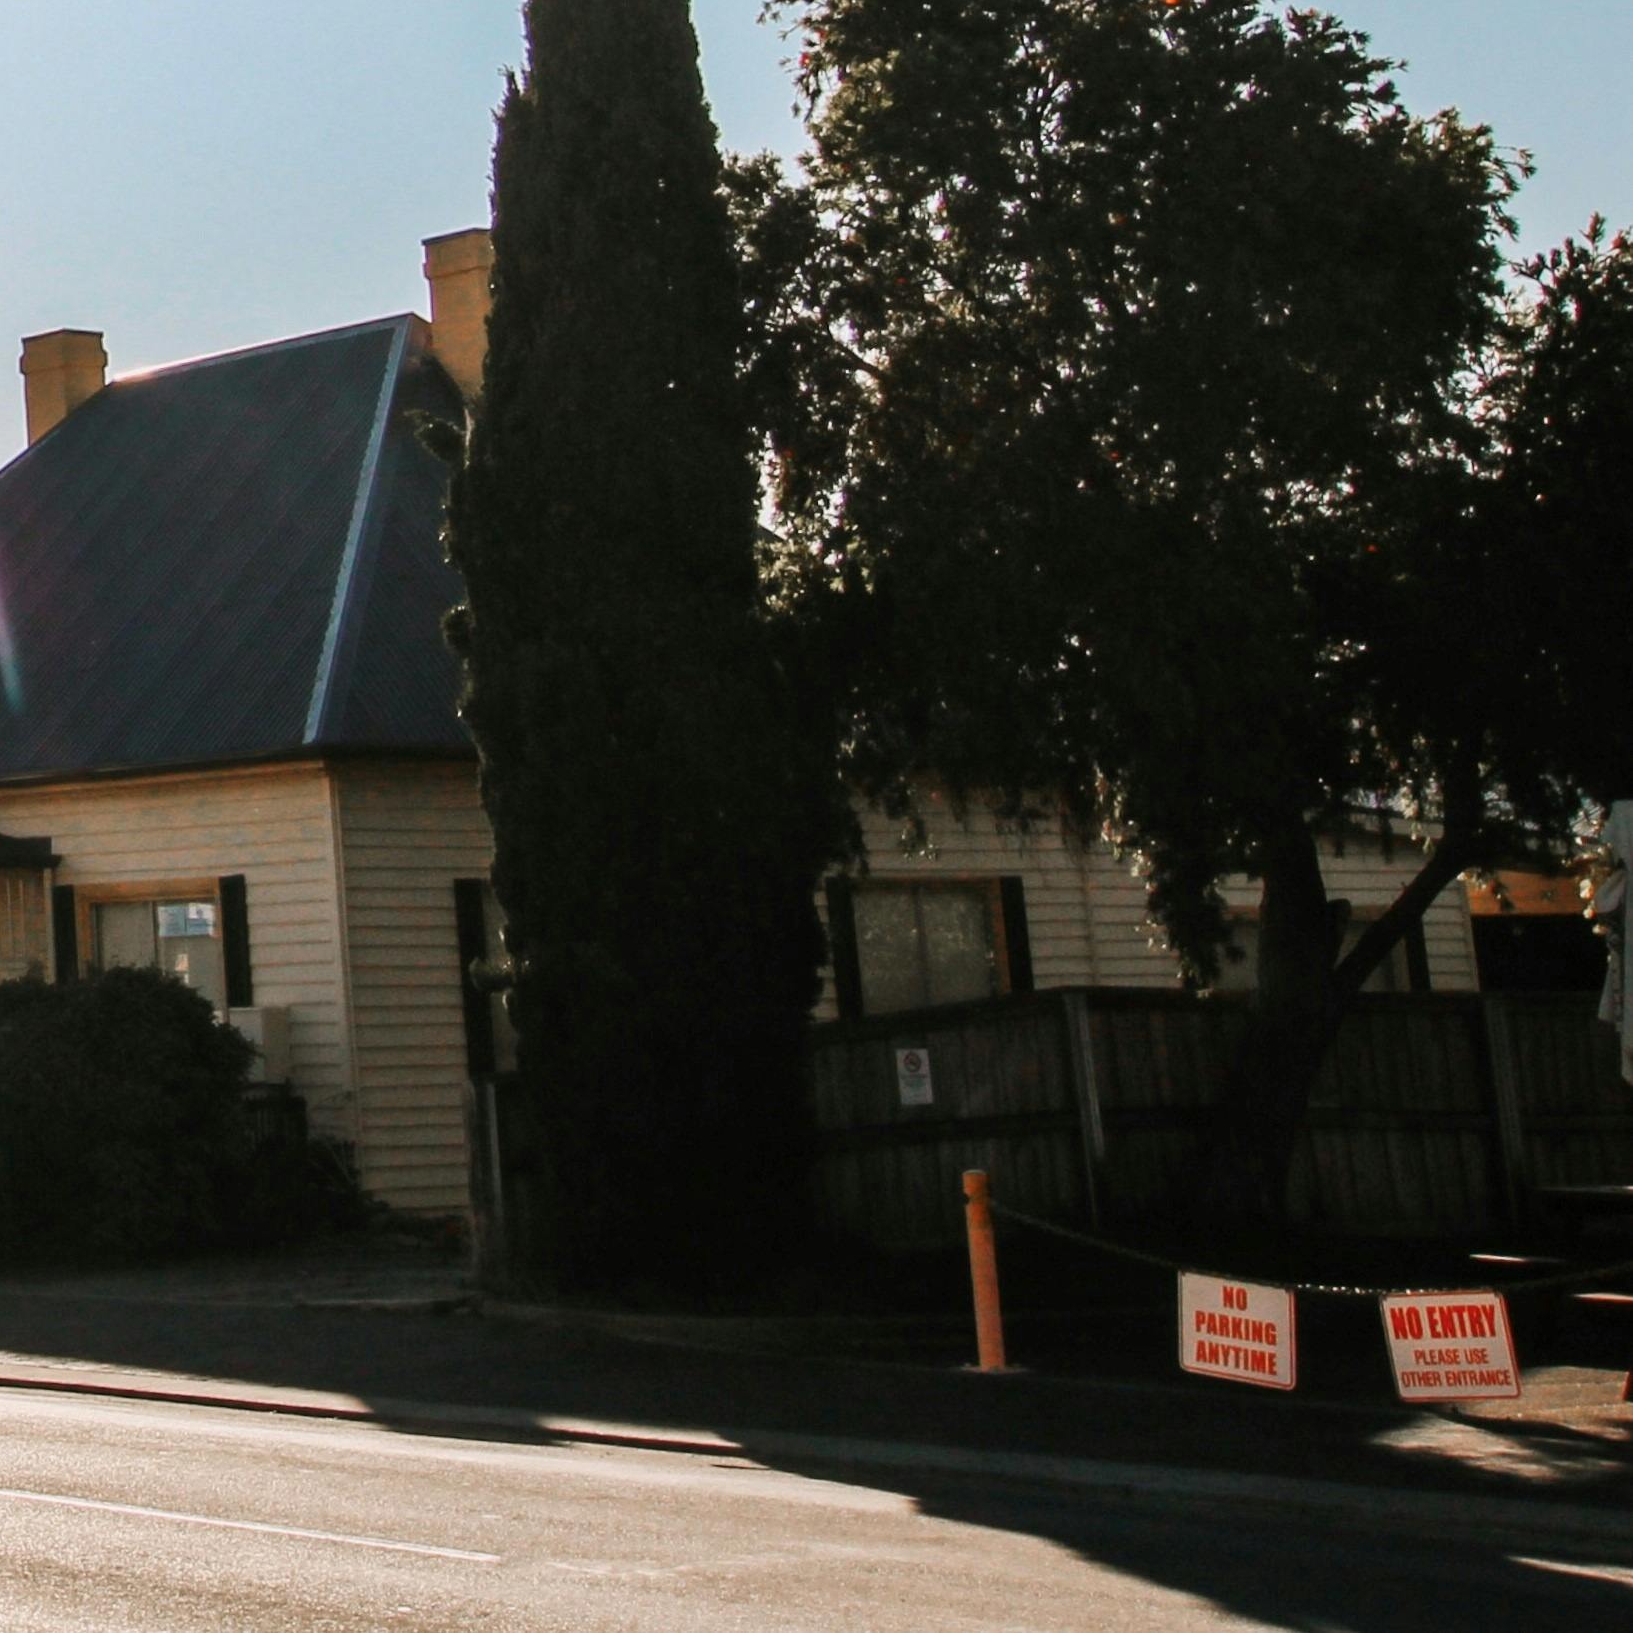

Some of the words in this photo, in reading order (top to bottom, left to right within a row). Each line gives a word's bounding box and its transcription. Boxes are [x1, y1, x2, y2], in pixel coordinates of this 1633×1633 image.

[1222, 1285, 1248, 1311] NO
[1195, 1310, 1277, 1346] PARKING
[1389, 1306, 1423, 1340] NO
[1425, 1304, 1496, 1339] ENTRY
[1195, 1339, 1277, 1376] ANYTIME
[1414, 1348, 1461, 1365] PLEASE
[1463, 1348, 1489, 1365] USE
[1401, 1371, 1443, 1388] OTHER
[1445, 1369, 1512, 1387] ENTRANCE
